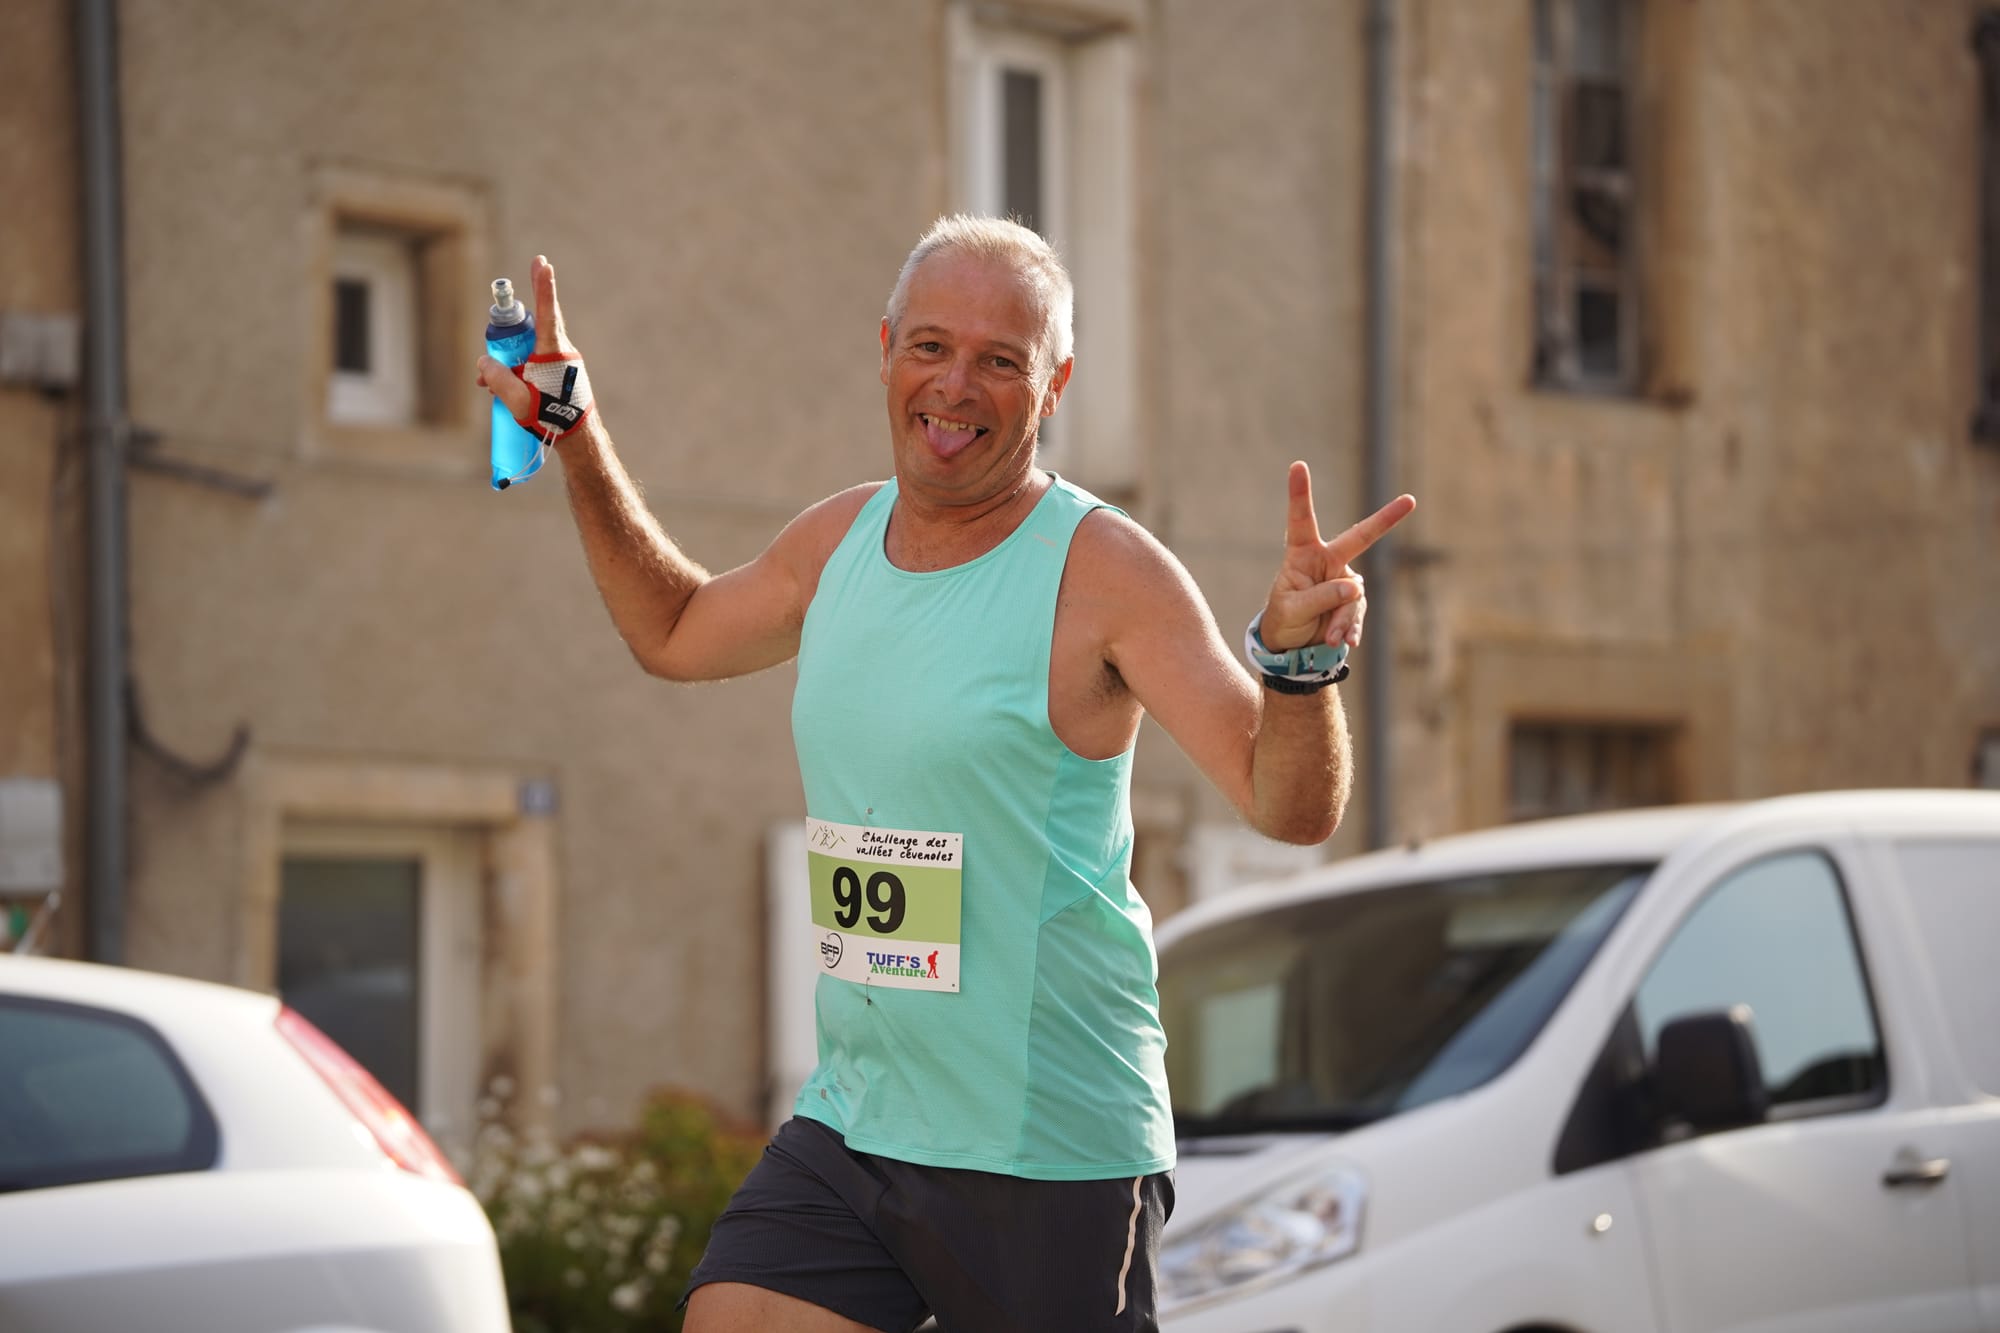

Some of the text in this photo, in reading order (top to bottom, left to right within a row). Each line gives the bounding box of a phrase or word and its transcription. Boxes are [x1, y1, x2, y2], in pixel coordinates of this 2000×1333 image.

[862, 832, 947, 849] Challenge des
[856, 845, 953, 861] vallées cévenoles
[833, 866, 906, 933] 99
[866, 952, 920, 968] TUFF'S
[870, 962, 927, 978] Aventure
